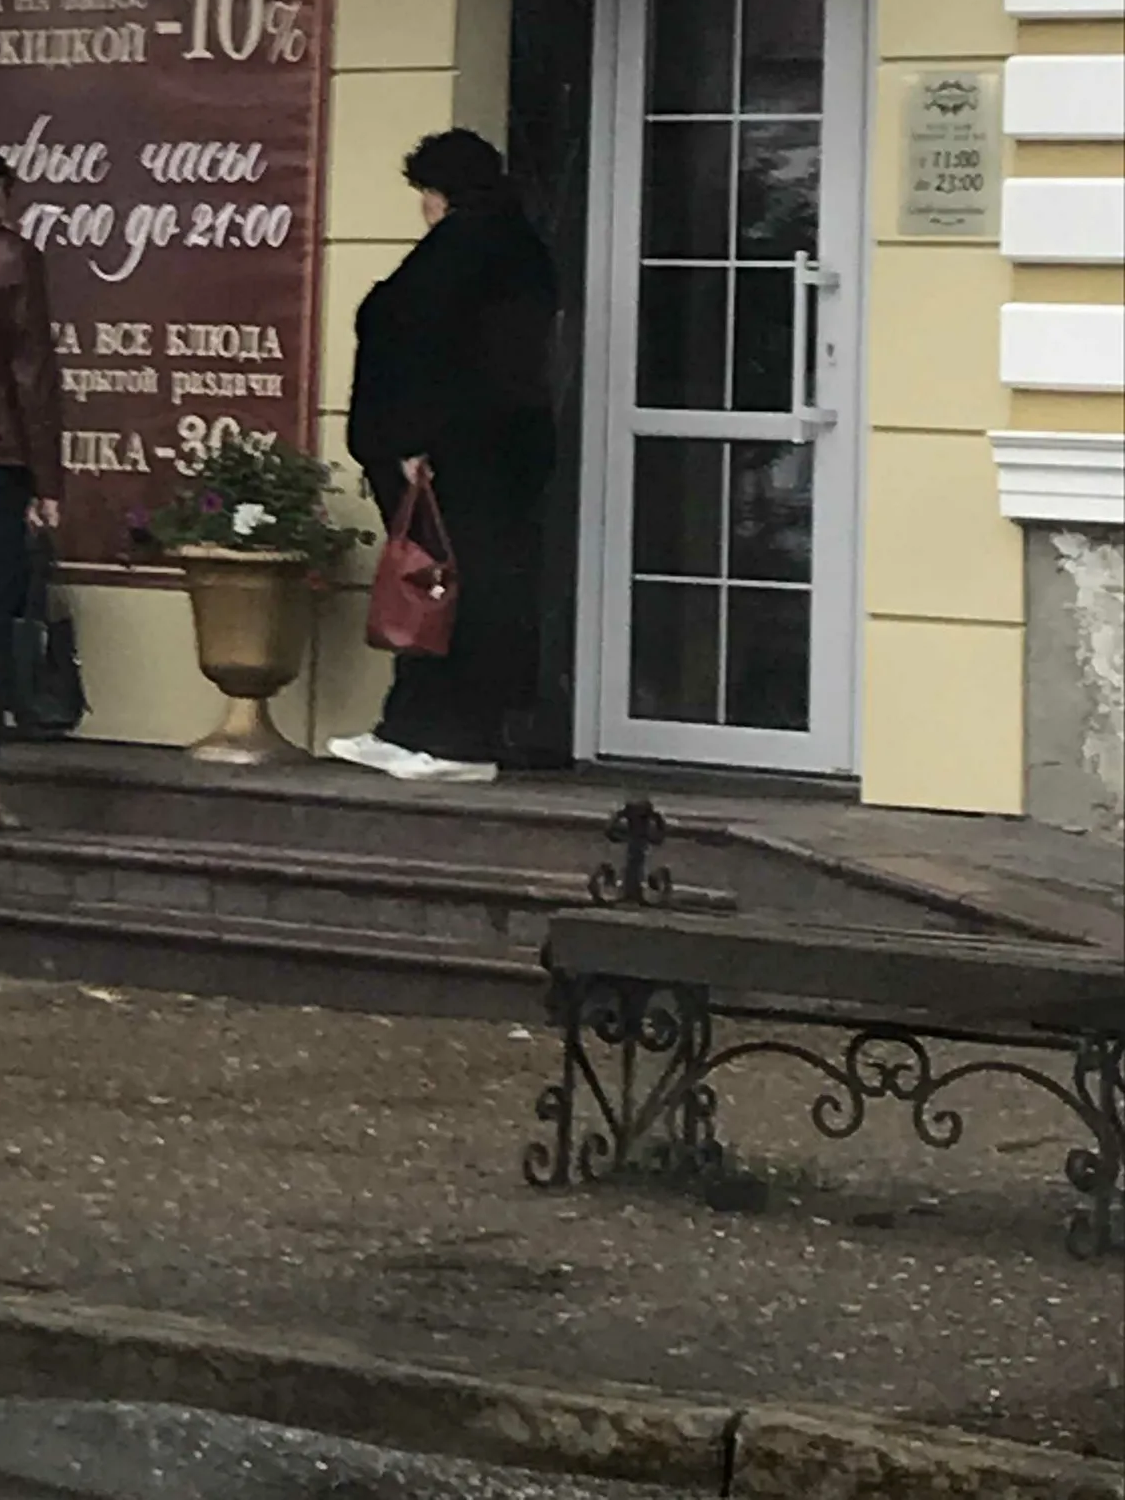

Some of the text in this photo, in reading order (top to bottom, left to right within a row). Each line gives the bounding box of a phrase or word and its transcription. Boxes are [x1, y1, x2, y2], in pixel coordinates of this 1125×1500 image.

[140, 140, 269, 184] часы
[182, 201, 292, 249] 21:00
[94, 322, 153, 356] ВСЕ
[165, 323, 284, 363] БЛЮДА
